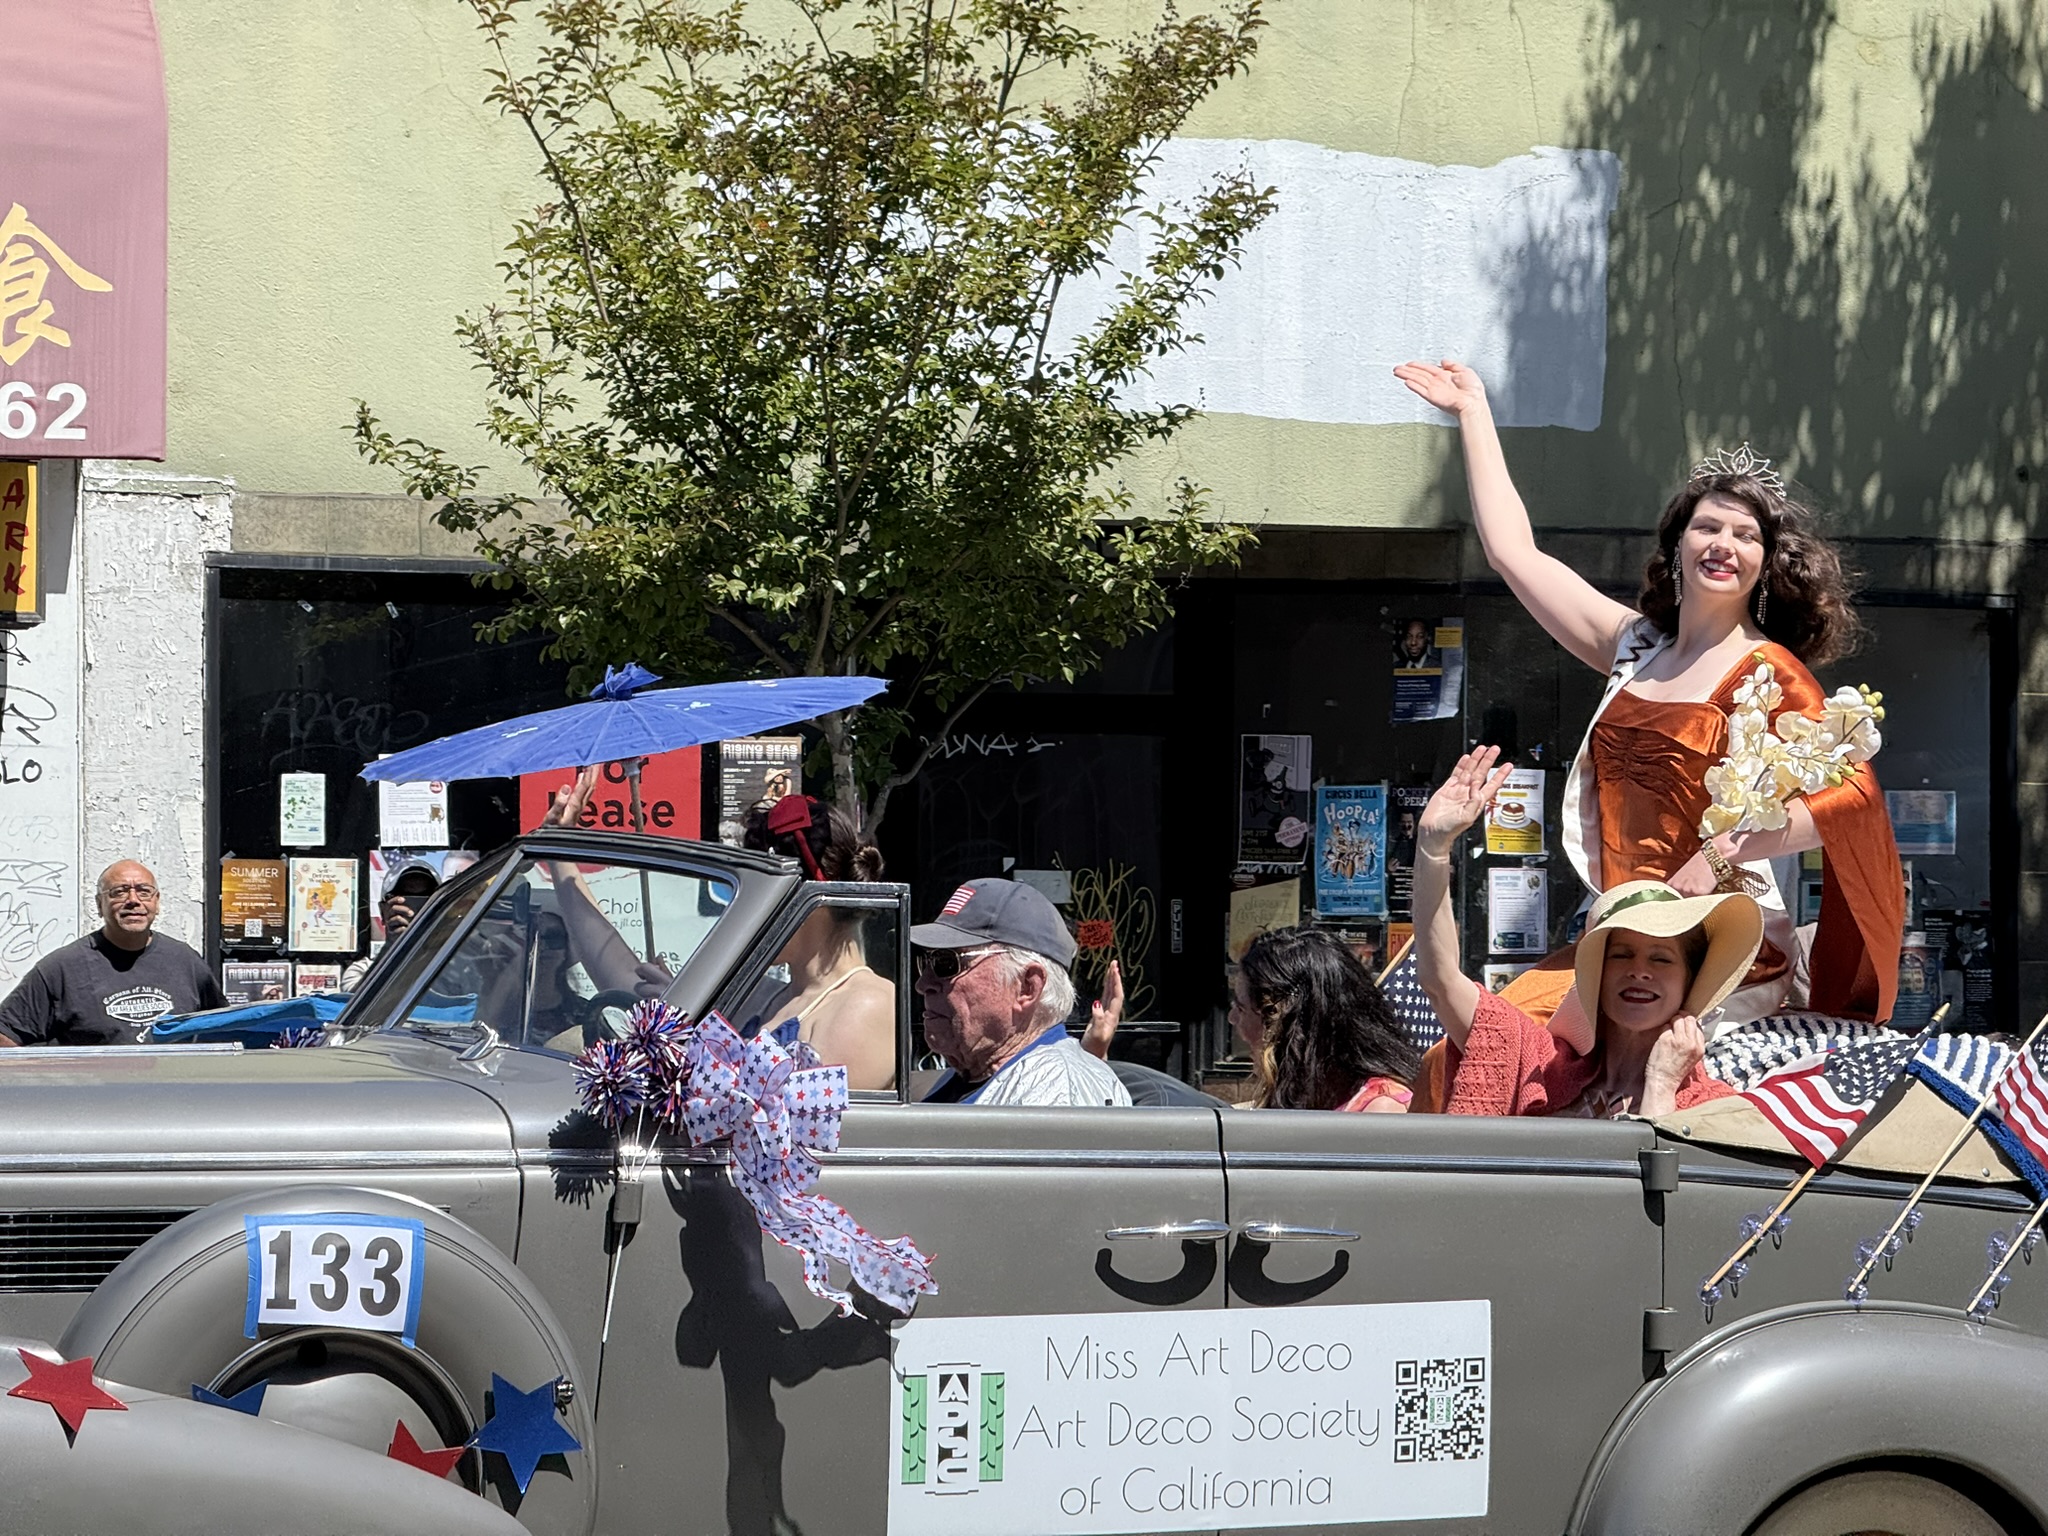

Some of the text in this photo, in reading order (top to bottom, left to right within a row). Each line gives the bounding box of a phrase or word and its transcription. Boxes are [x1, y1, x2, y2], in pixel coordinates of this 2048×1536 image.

[0, 381, 88, 441] 62
[723, 744, 799, 756] RISING SEAS
[0, 758, 43, 785] LO
[1325, 789, 1378, 799] CIRCUS BELLA
[1391, 787, 1431, 797] POCKET
[1397, 796, 1429, 807] OPERA
[230, 867, 279, 878] SUMMER
[597, 898, 639, 916] Choi
[228, 968, 286, 977] RISING SEAS
[108, 1002, 172, 1014] BAY AREA BLUES SOCIETY
[266, 1230, 403, 1317] 133
[1045, 1329, 1352, 1382] Miss Art Deco
[1012, 1396, 1381, 1450] Art Deco Society
[1059, 1466, 1333, 1517] of California
